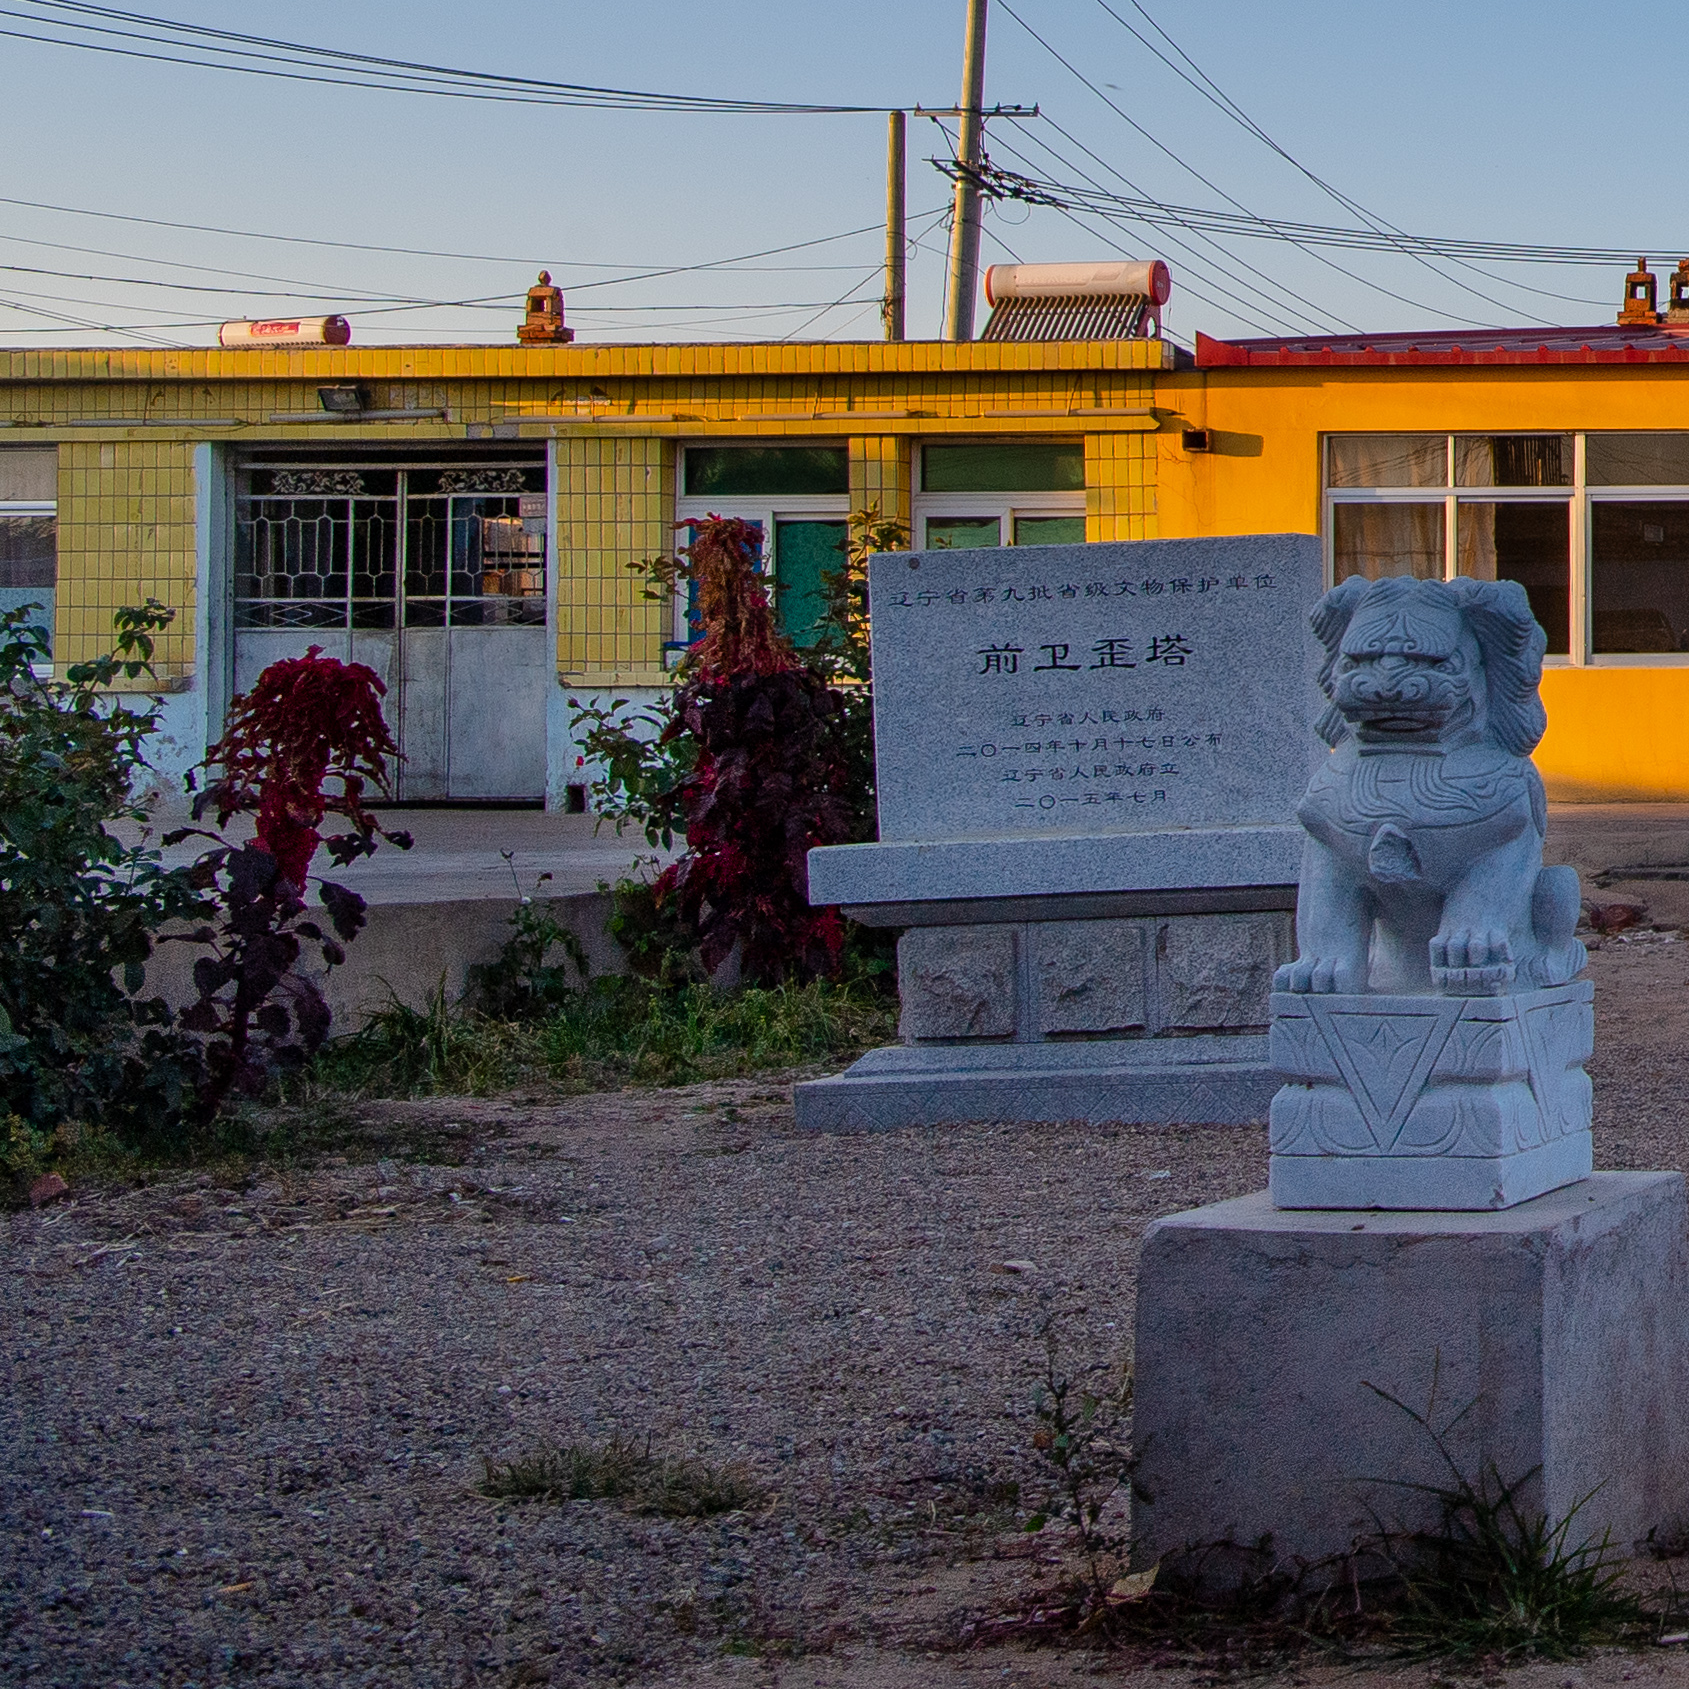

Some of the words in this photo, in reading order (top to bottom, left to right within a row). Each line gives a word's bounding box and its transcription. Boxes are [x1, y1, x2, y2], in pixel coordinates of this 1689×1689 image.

[888, 573, 1279, 608] 辽宁省第九批省级文物保护单位
[977, 634, 1194, 675] 前卫歪塔
[1010, 707, 1166, 728] 辽宁省人民政府
[1001, 762, 1180, 784] 辽宁省人民政府立
